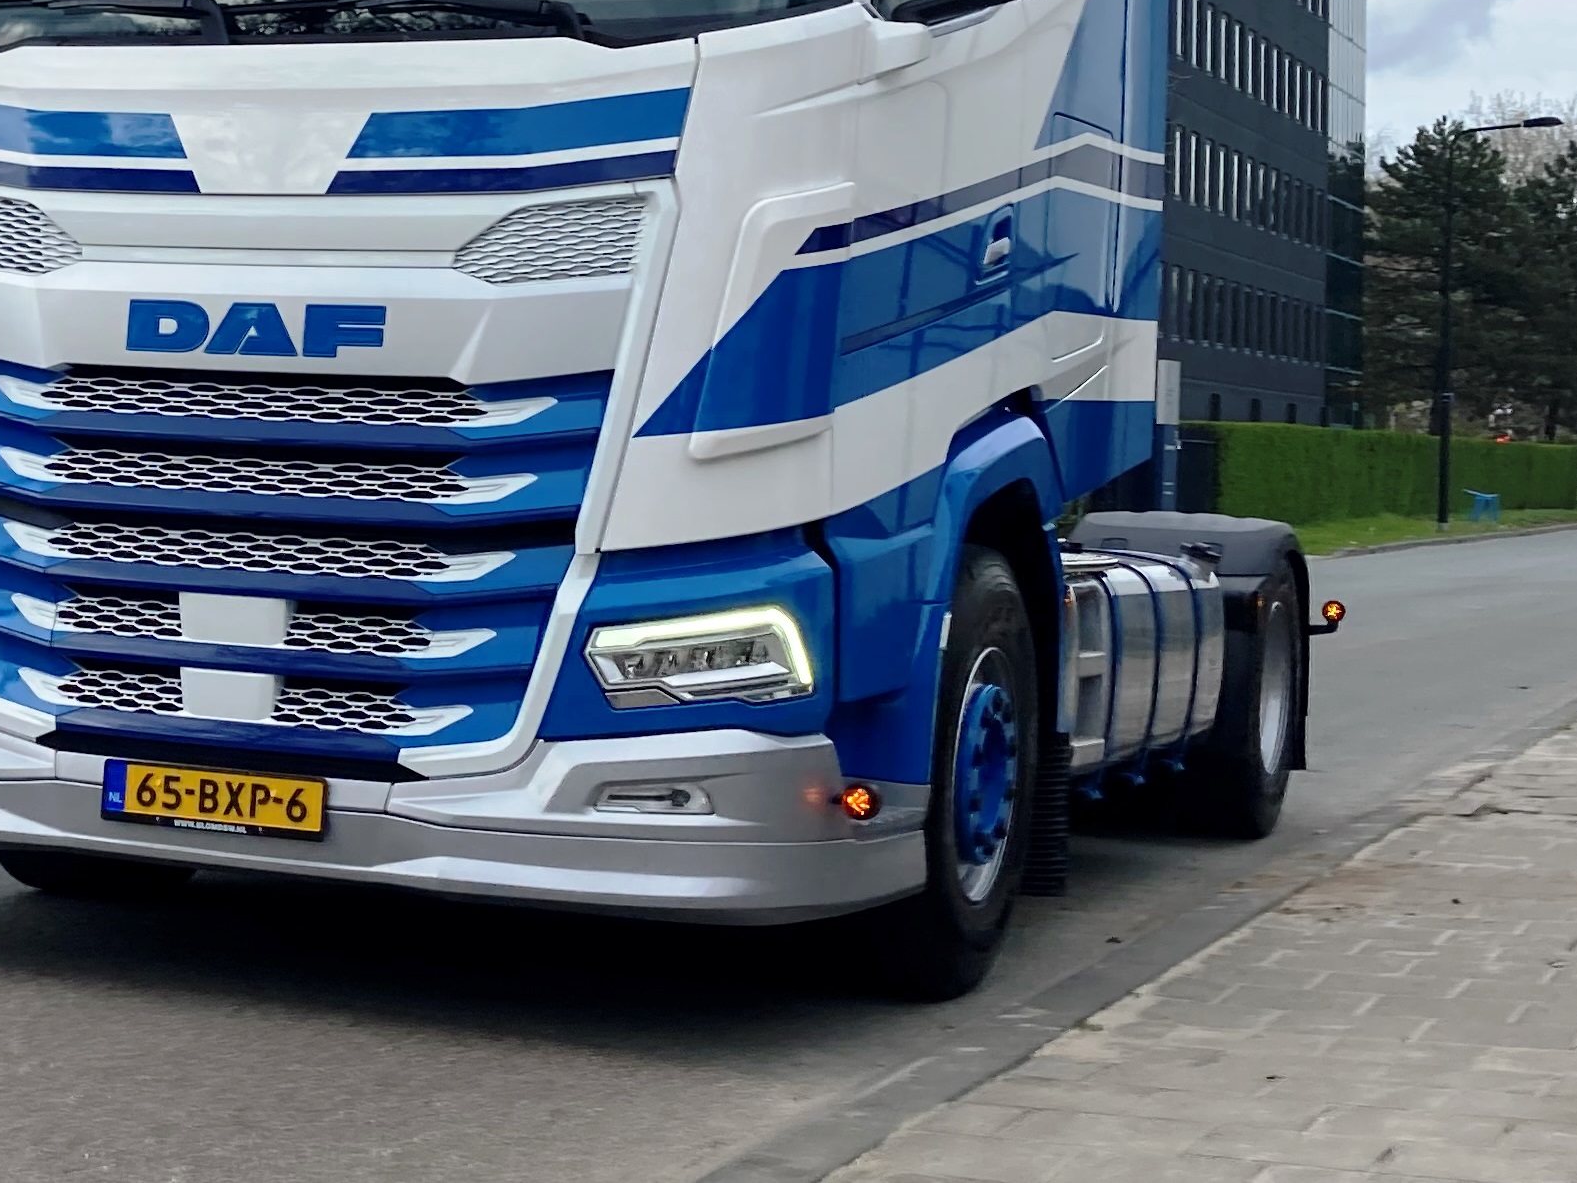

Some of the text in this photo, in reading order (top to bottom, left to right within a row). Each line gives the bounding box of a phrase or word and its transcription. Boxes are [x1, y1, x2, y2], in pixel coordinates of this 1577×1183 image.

[126, 299, 386, 357] DAF
[108, 791, 123, 804] NL
[136, 773, 308, 822] 65-BXP-6
